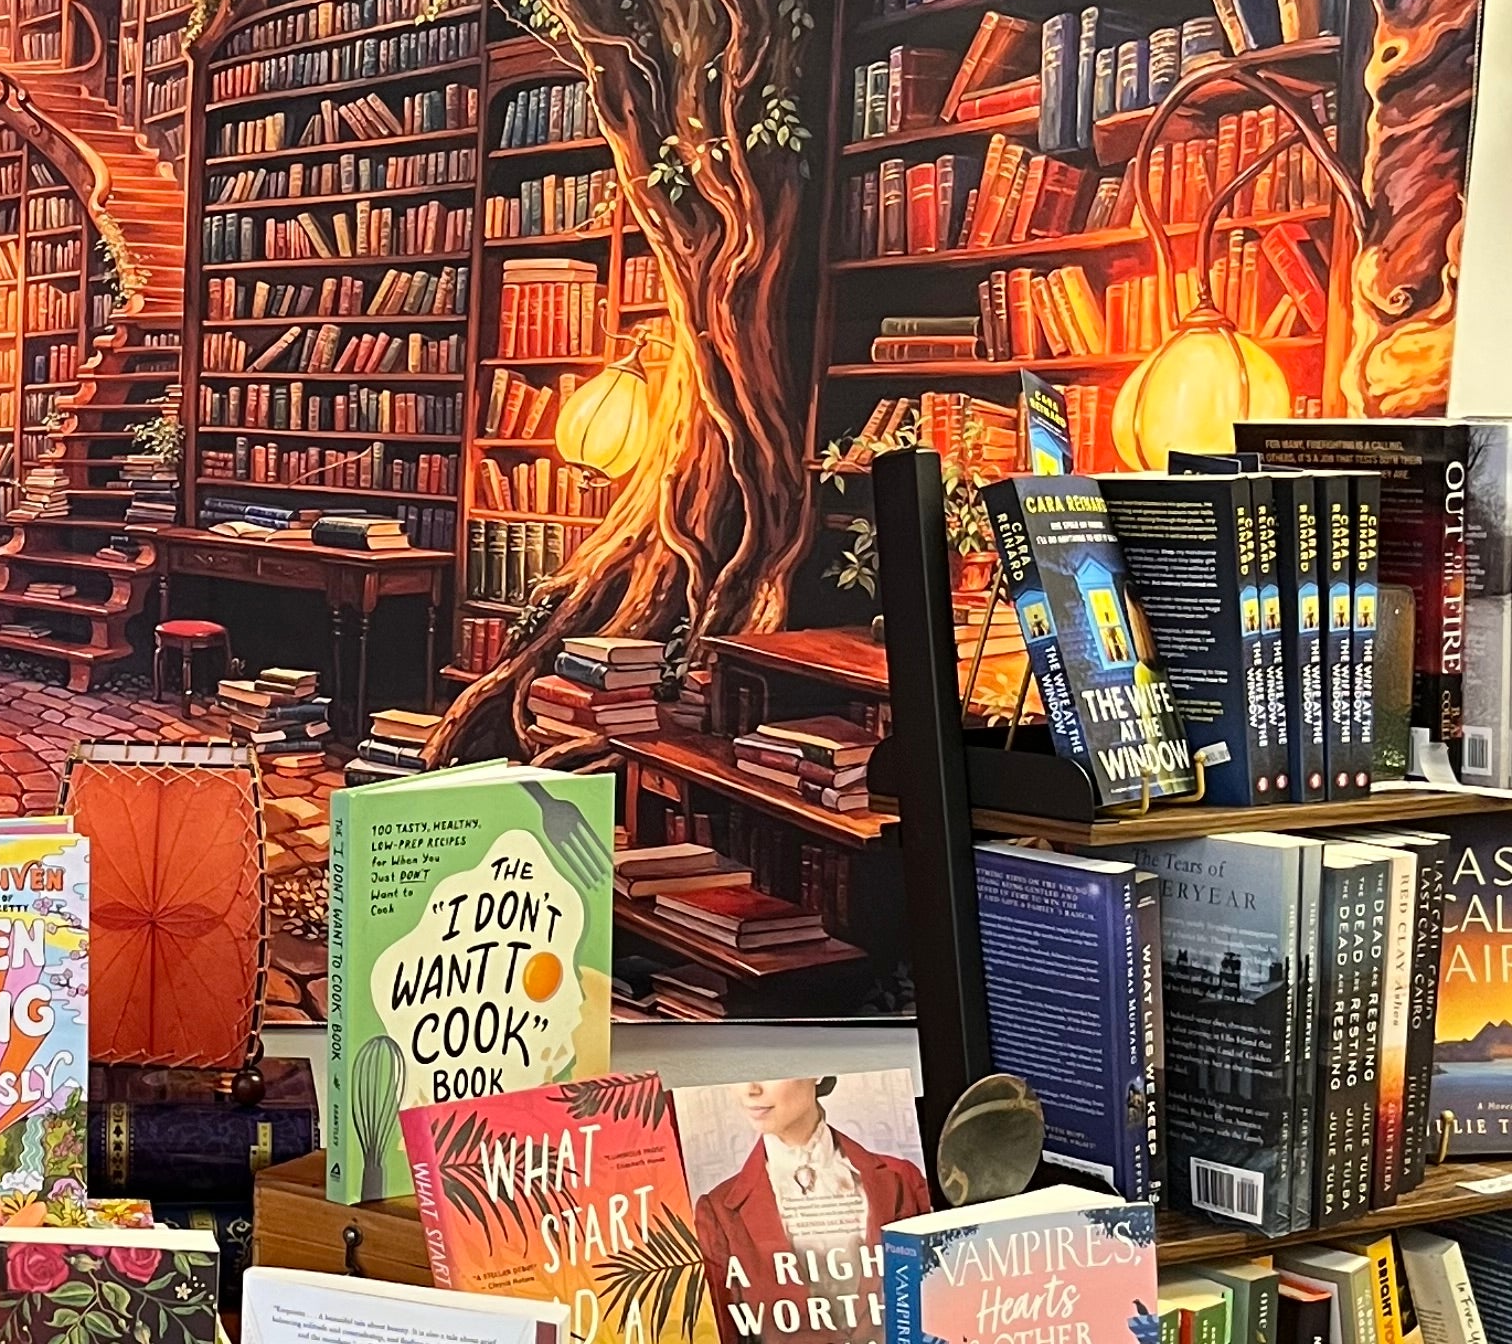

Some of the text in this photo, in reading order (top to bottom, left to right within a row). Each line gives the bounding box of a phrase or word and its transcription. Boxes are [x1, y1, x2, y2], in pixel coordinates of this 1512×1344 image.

[996, 513, 1024, 581] REINARD
[1011, 522, 1031, 567] CARA
[1441, 460, 1466, 675] OUT FIRE
[1042, 674, 1067, 735] WINDOW
[1044, 645, 1084, 754] THE WIFE AT THE
[1081, 681, 1174, 722] THE WIFE
[1120, 716, 1162, 741] AT THE
[1098, 738, 1190, 781] WINDOW
[371, 835, 467, 852] LOW-PREP RECIPES
[491, 856, 533, 881] THE
[371, 868, 429, 884] Just DON'T
[371, 904, 394, 916] Cook
[473, 891, 562, 943] DON'T
[1396, 874, 1410, 975] RED CLAY
[1364, 898, 1384, 1082] DEAD RESTING
[1142, 944, 1157, 1156] WHAT LIES WE KEEP
[434, 1067, 504, 1102] BOOK
[481, 1124, 601, 1203] WHAT
[1324, 1112, 1337, 1216] JULIE TULBA
[542, 1185, 655, 1275] START
[934, 1220, 1143, 1288] VAMPIRES,
[725, 1245, 885, 1289] A RIGH
[1377, 1257, 1394, 1317] BRIGHT
[976, 1274, 1080, 1334] Hearts
